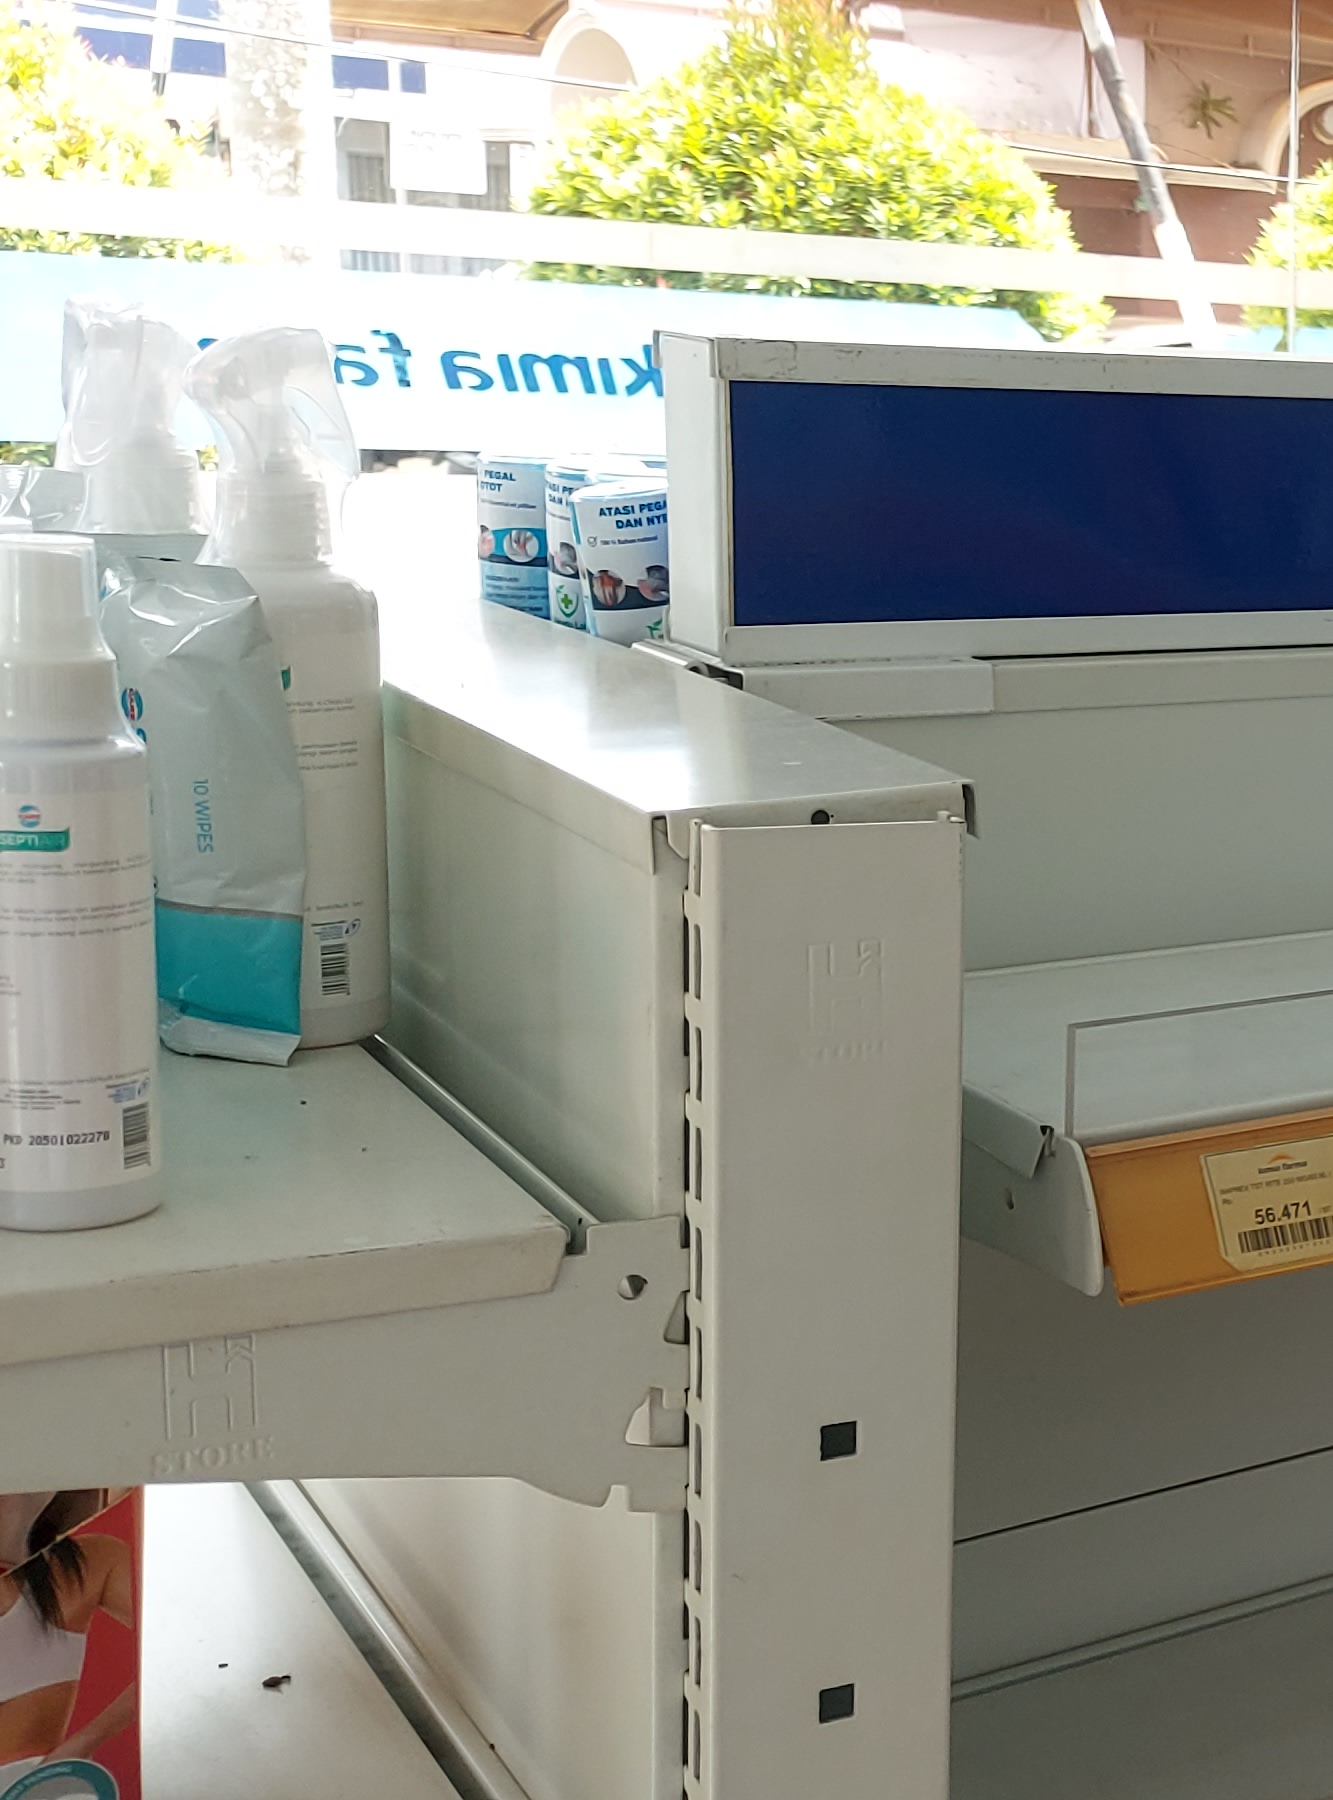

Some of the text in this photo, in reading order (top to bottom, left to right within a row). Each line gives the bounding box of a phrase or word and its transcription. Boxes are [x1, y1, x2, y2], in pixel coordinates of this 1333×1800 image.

[599, 505, 635, 518] ATASI
[616, 518, 643, 530] DAN
[193, 778, 214, 853] 10 WIPES
[1255, 1199, 1312, 1225] 56.471
[151, 1434, 276, 1477] STORE
